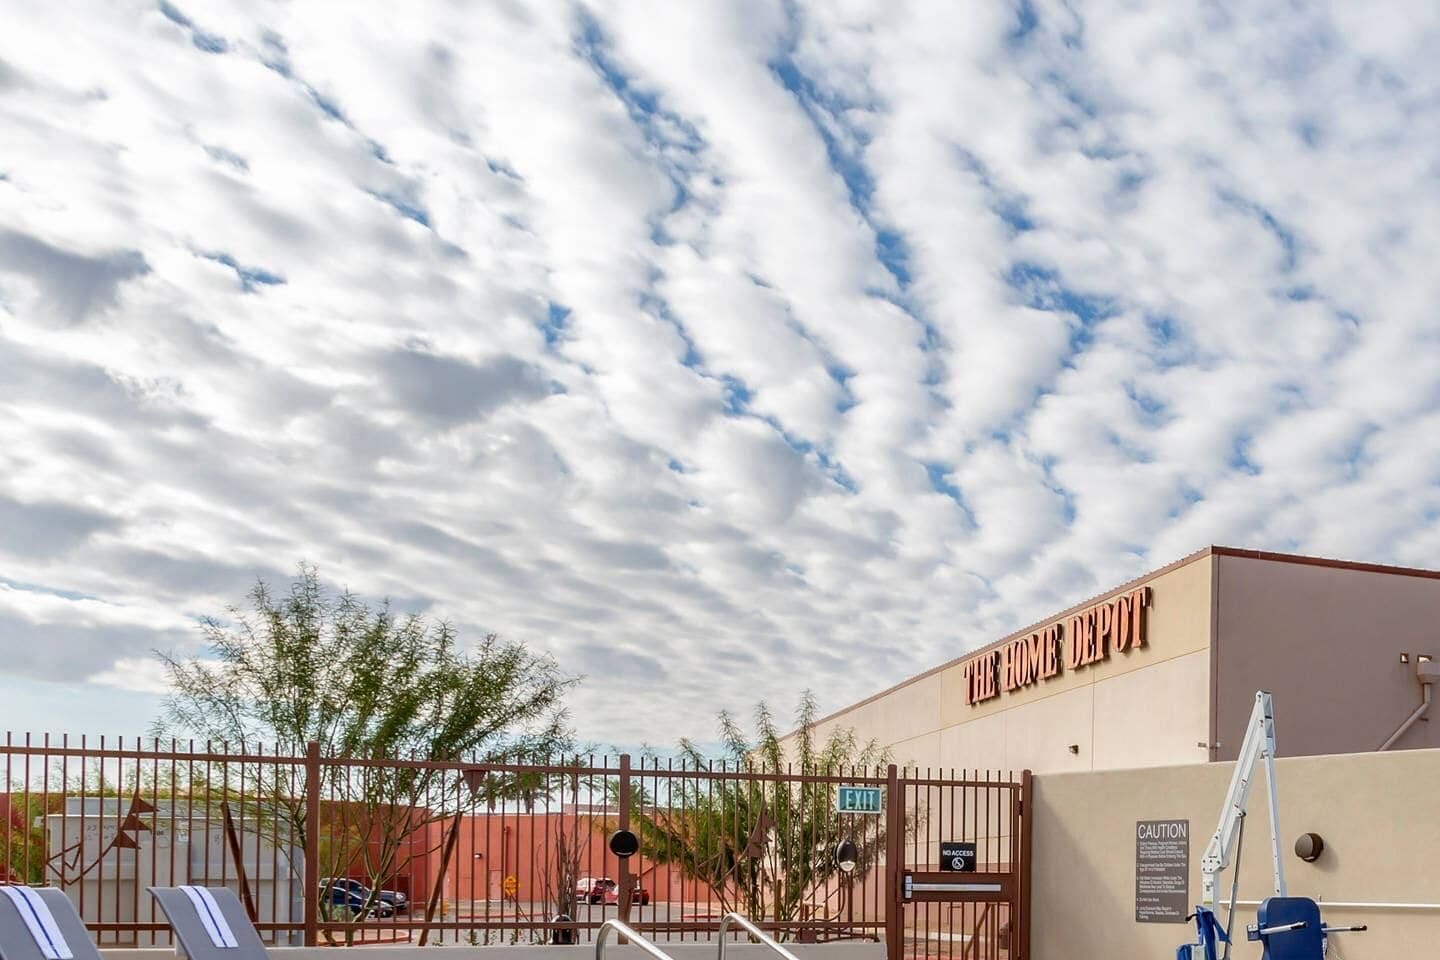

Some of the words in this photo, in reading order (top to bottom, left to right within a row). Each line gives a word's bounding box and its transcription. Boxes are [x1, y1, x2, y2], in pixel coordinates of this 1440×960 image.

[964, 651, 1000, 705] THE
[1003, 623, 1062, 692] HOME
[1067, 586, 1152, 671] DEPOT
[845, 790, 875, 811] EXIT
[1138, 823, 1187, 839] CAUTION
